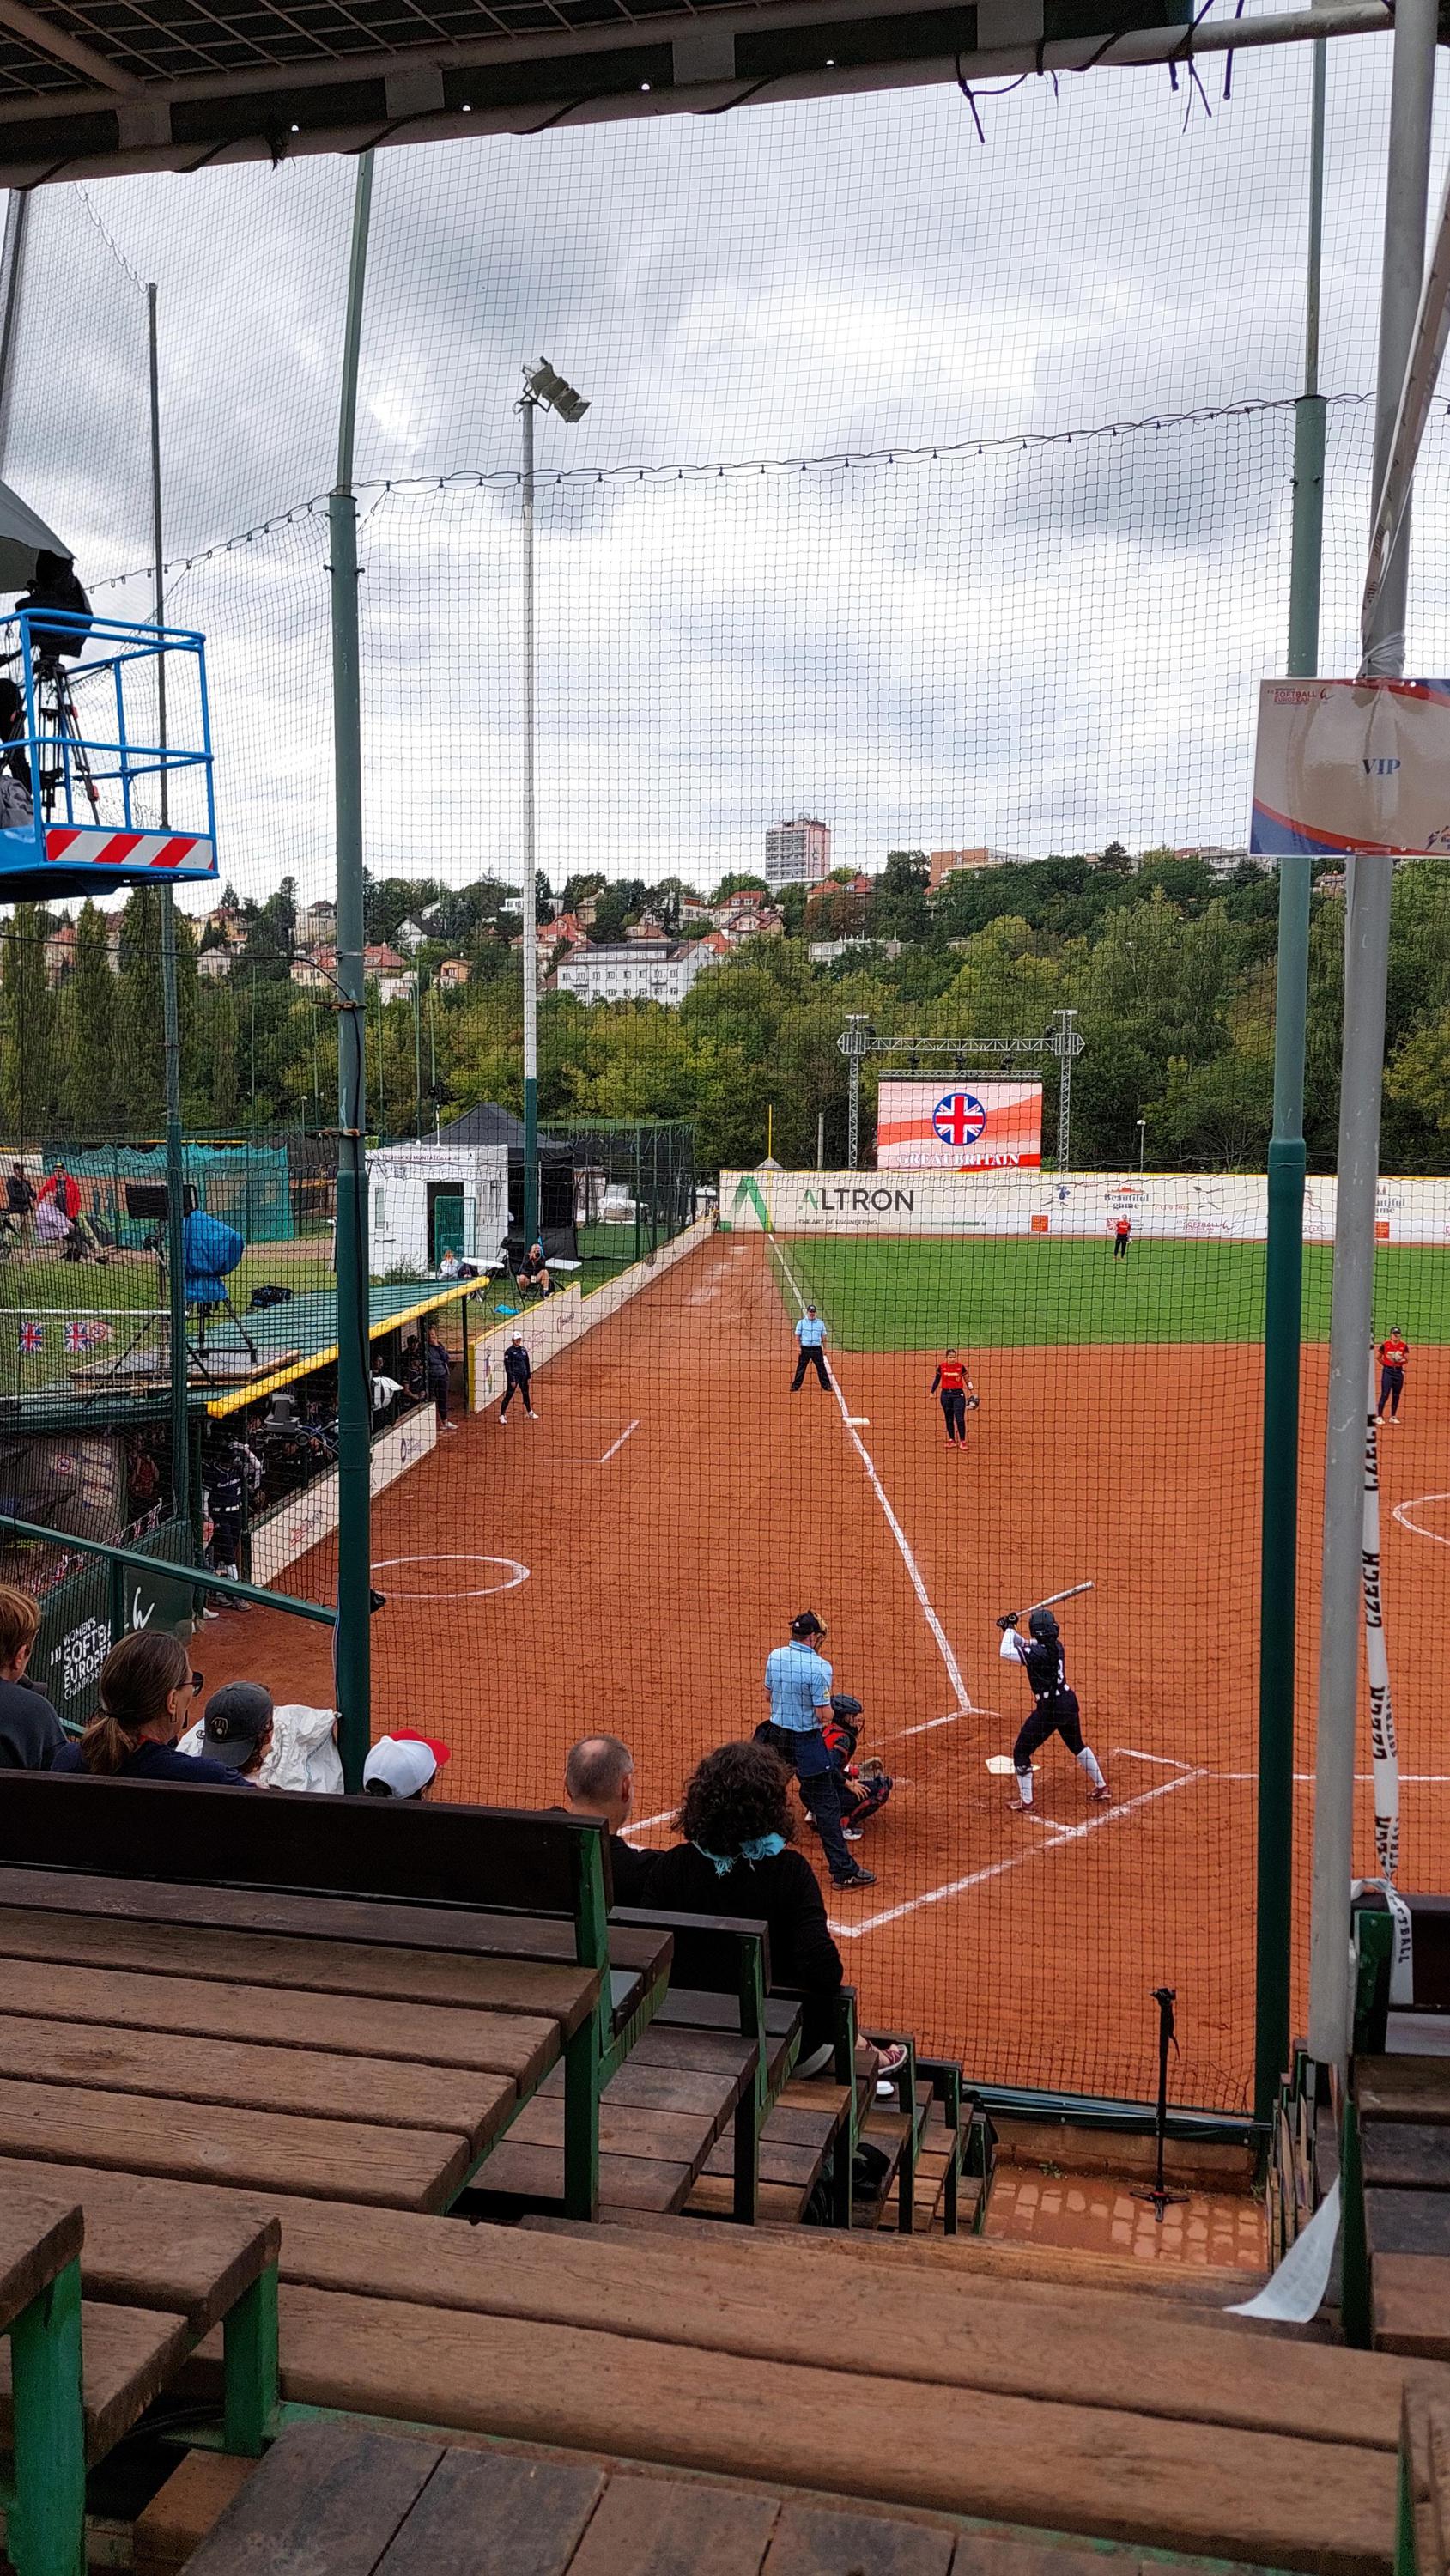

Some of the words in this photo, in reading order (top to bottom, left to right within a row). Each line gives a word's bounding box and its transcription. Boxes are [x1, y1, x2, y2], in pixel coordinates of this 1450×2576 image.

[1362, 758, 1401, 775] VIP
[899, 1153, 953, 1165] GREAT
[954, 1153, 1020, 1166] BRITAIN
[798, 1188, 914, 1212] ALTRON
[1104, 1194, 1150, 1202] Beautiful
[1362, 1549, 1382, 1628] CZECH
[1370, 1686, 1388, 1759] CZECH
